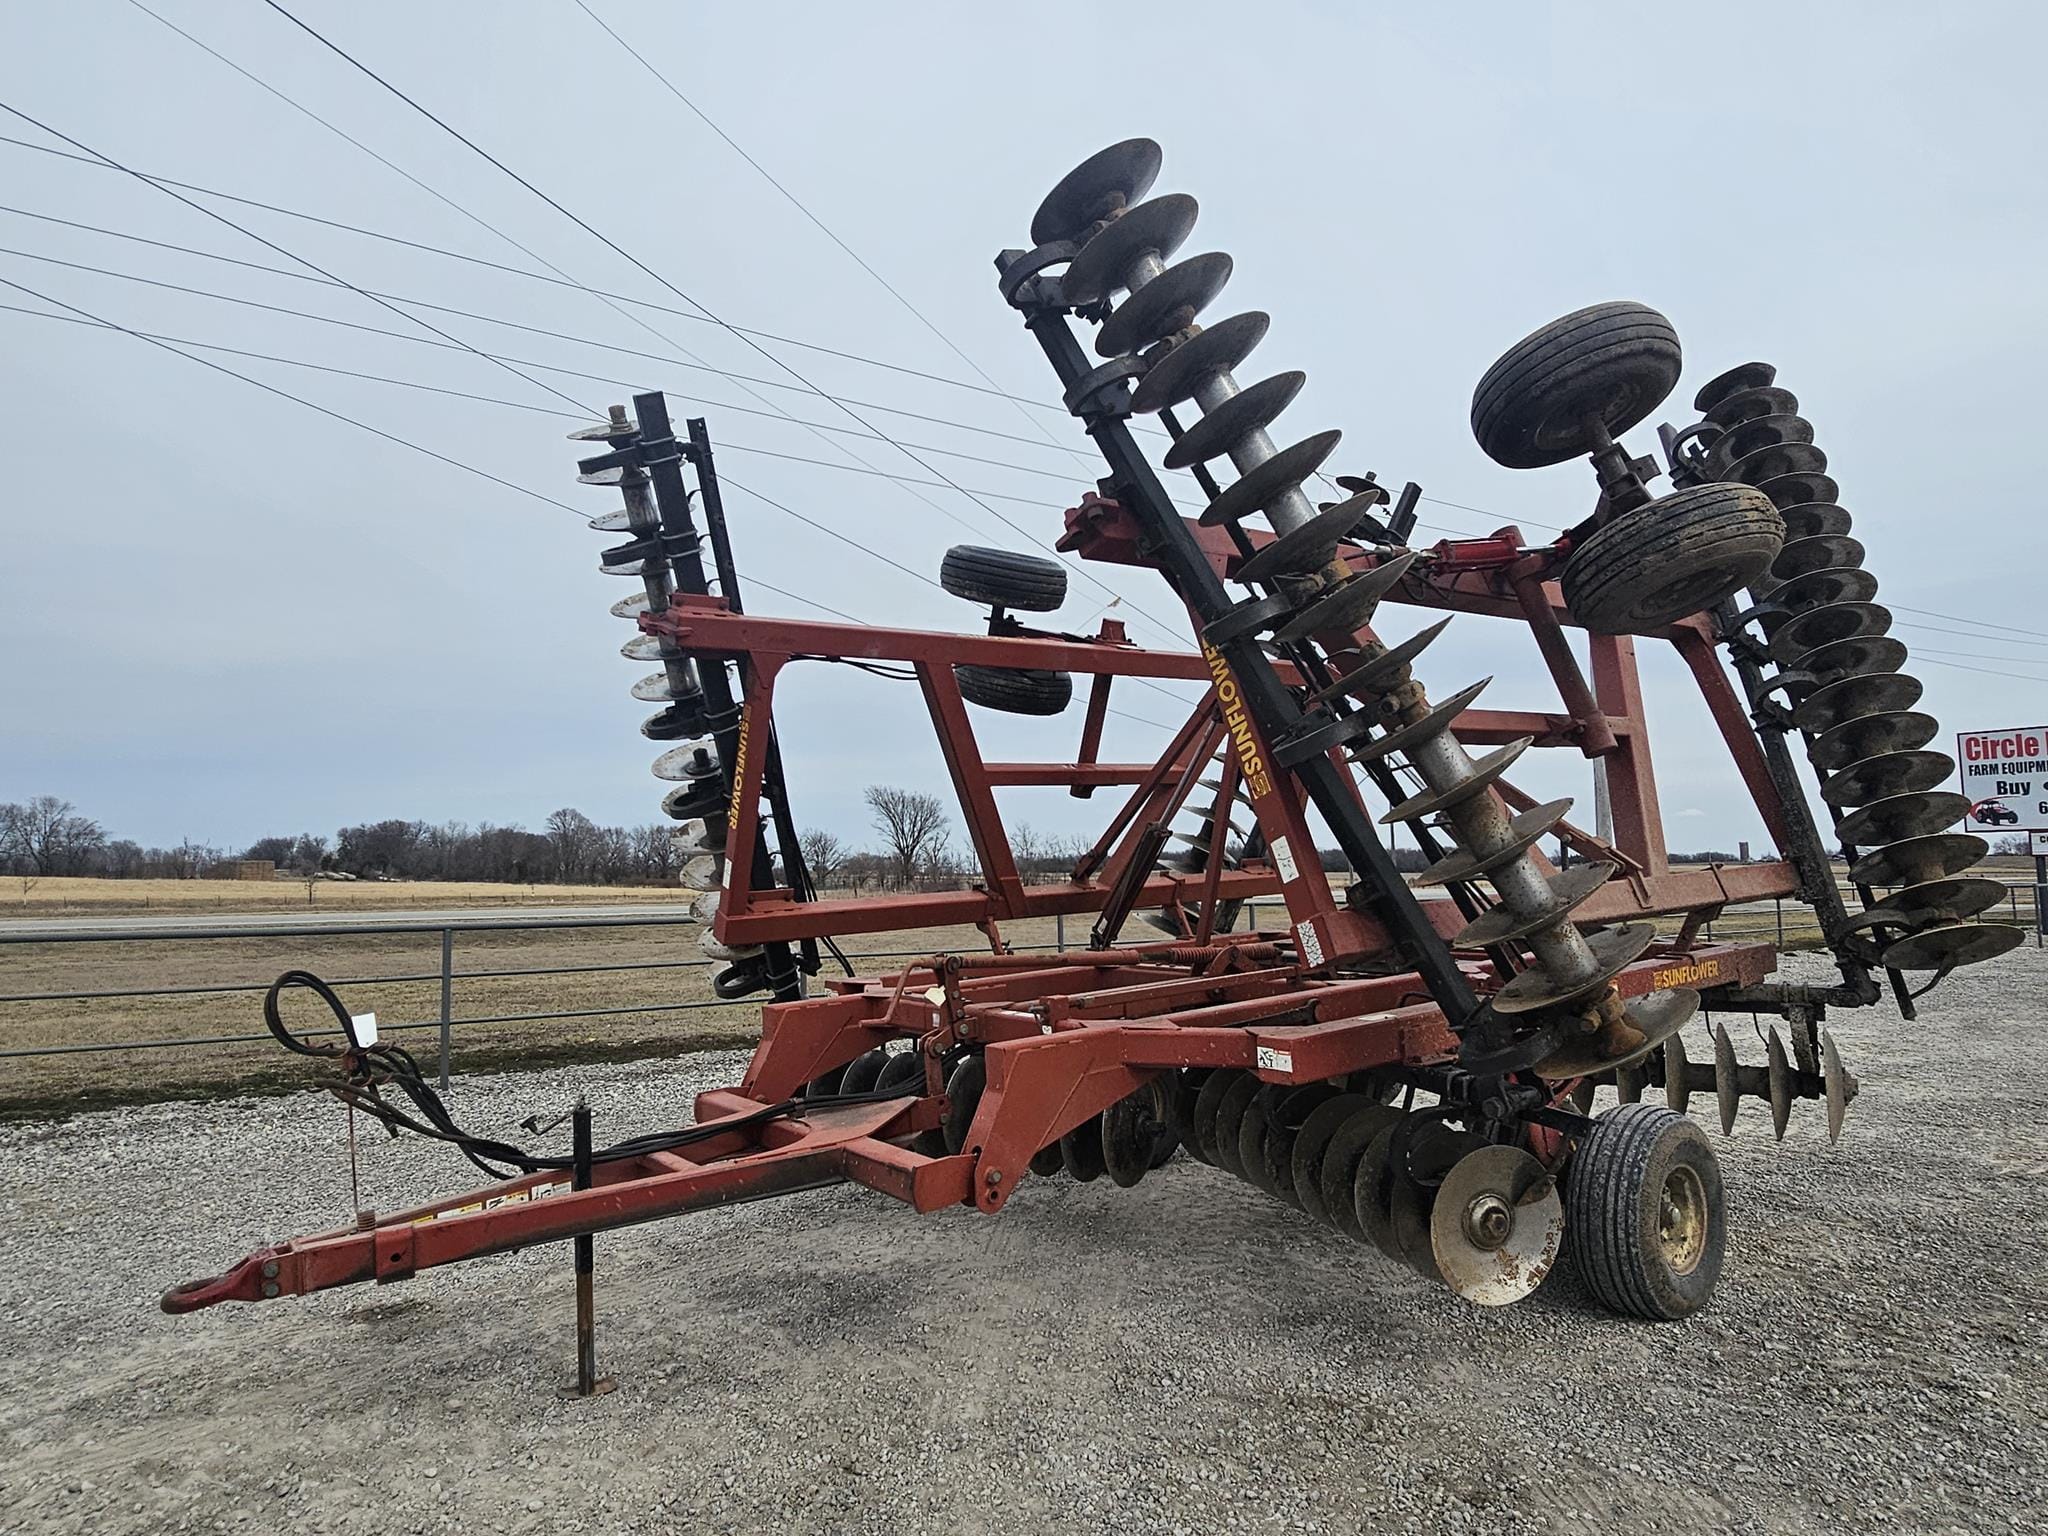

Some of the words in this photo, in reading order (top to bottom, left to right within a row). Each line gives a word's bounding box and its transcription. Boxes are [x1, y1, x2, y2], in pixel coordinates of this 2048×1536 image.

[1201, 637, 1263, 777] SUNFLOWE
[1965, 733, 2040, 761] Circle
[728, 720, 750, 830] SUNFLOWER
[1968, 764, 1999, 777] FARM
[1996, 780, 2031, 796] Buy
[1662, 960, 1719, 988] SUNFLOWER
